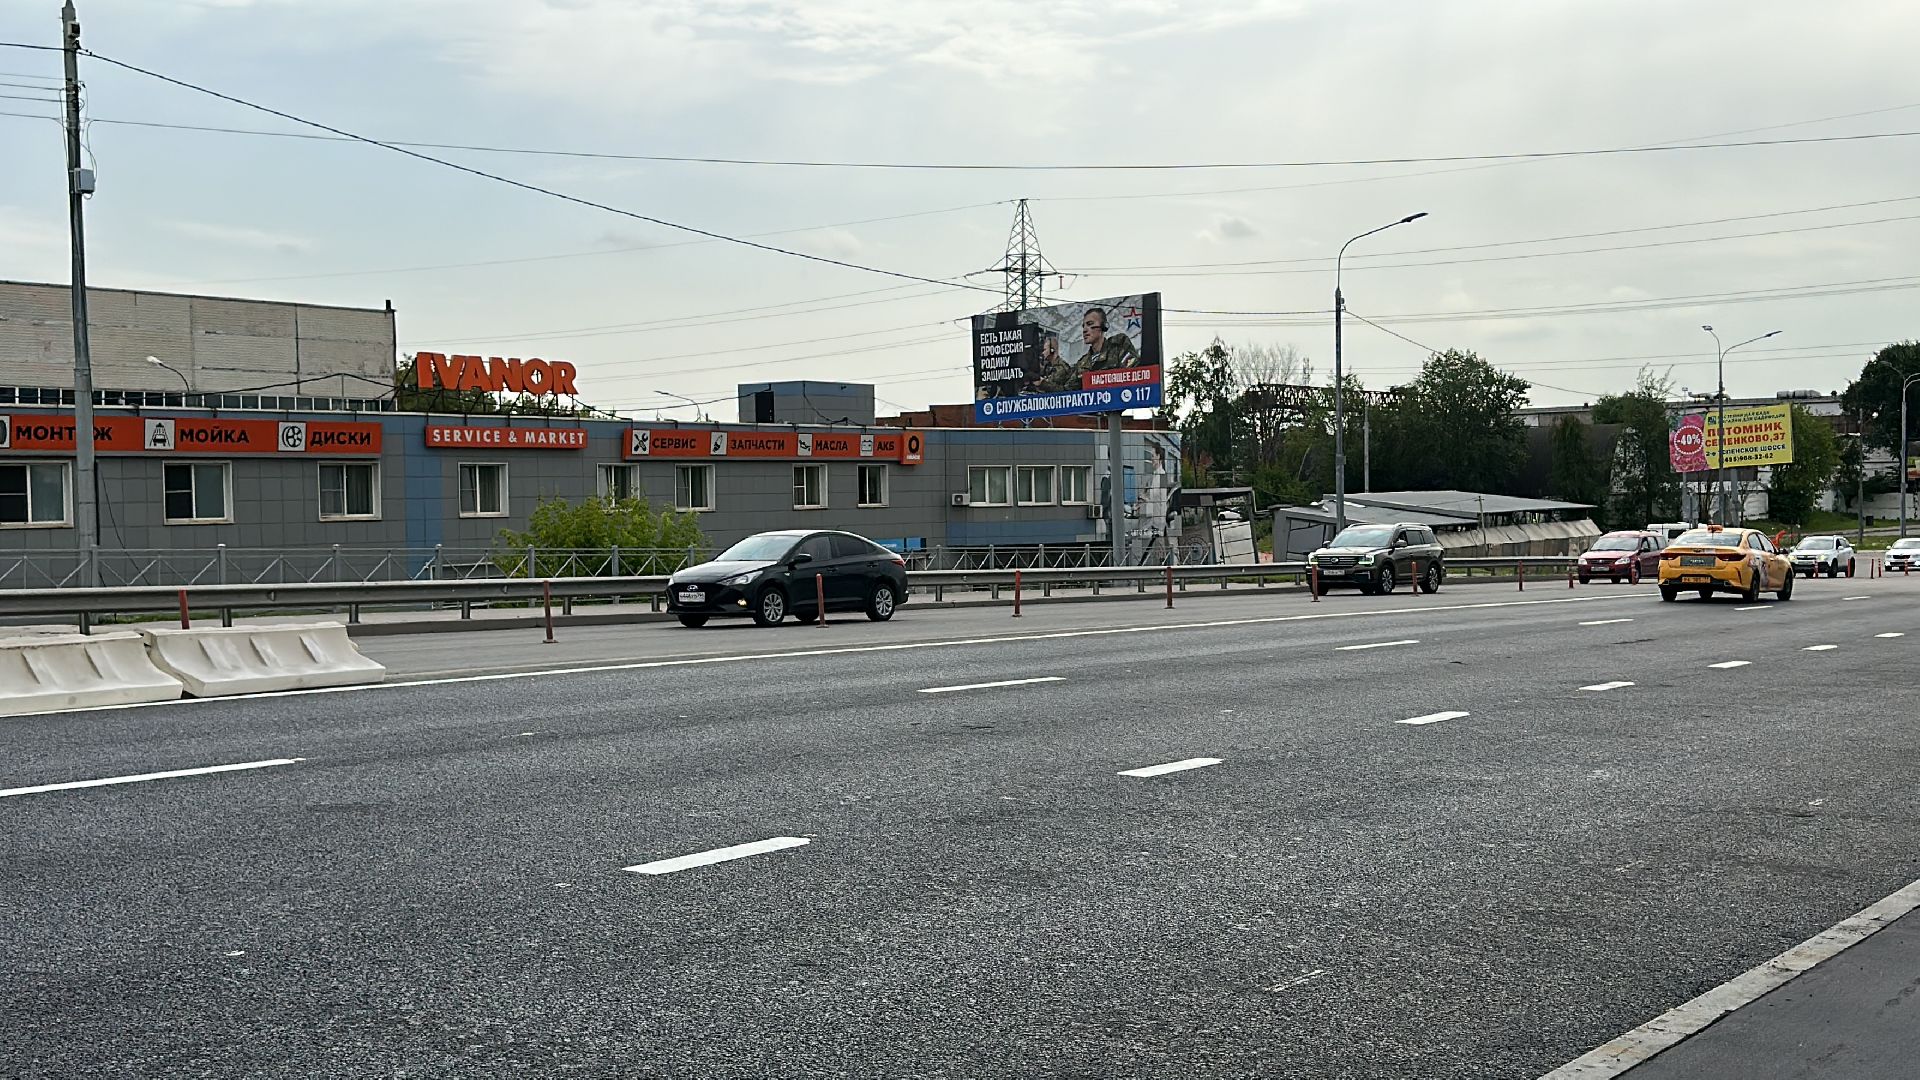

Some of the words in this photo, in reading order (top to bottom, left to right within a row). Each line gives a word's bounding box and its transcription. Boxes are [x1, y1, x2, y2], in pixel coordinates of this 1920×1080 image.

[980, 332, 998, 344] ЕСТЬ
[999, 329, 1022, 343] ТАКАЯ
[980, 341, 1024, 357] ПРОФЕССИЯ
[981, 356, 1010, 370] РОДИНУ
[417, 351, 579, 395] IVANOR
[981, 367, 1024, 382] ЗАЩИЩАТЬ
[1091, 371, 1131, 385] НАСТОЯЩЕЕ
[1132, 369, 1151, 382] ДЕЛО
[1135, 386, 1151, 401] 117
[996, 390, 1112, 415] СЛУЖБАПОКОНТРАКТУ.РФ
[16, 425, 113, 441] МОНТЖ
[179, 426, 250, 443] МОЙКА
[433, 428, 501, 443] SERVICE
[508, 431, 518, 443] &
[525, 431, 584, 445] MARKET
[1707, 421, 1783, 437] ПТОМНИК
[310, 431, 371, 446] ДИСКИ
[652, 437, 697, 449] СЕРВИС
[731, 439, 785, 451] ЗАПЧАСТИ
[815, 440, 848, 451] МАСЛА
[877, 441, 895, 451] АКБ
[1677, 433, 1701, 446] -40%
